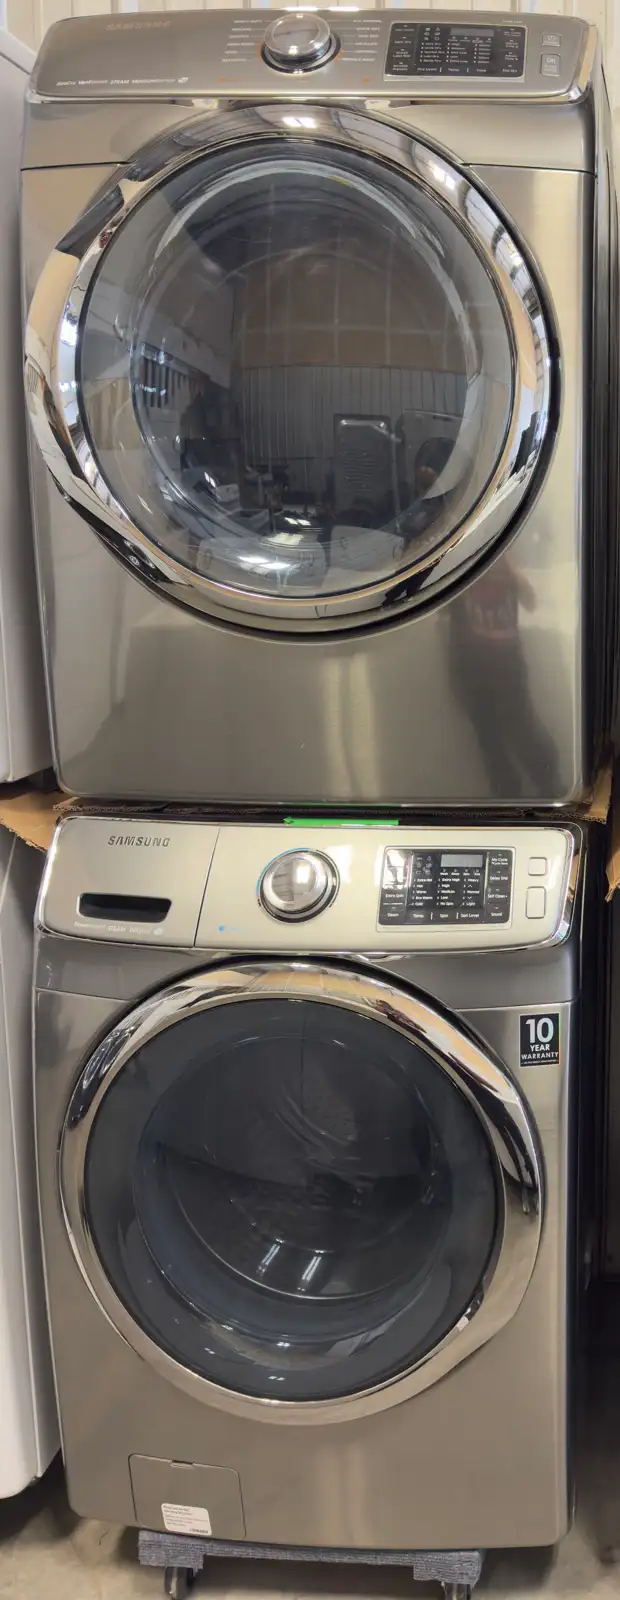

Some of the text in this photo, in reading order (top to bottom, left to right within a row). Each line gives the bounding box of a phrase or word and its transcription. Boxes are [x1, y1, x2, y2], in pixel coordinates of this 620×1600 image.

[108, 835, 170, 847] SAMSUNG
[525, 1017, 554, 1043] 10
[530, 1044, 550, 1052] YEAR
[521, 1052, 559, 1060] WARRANTY
